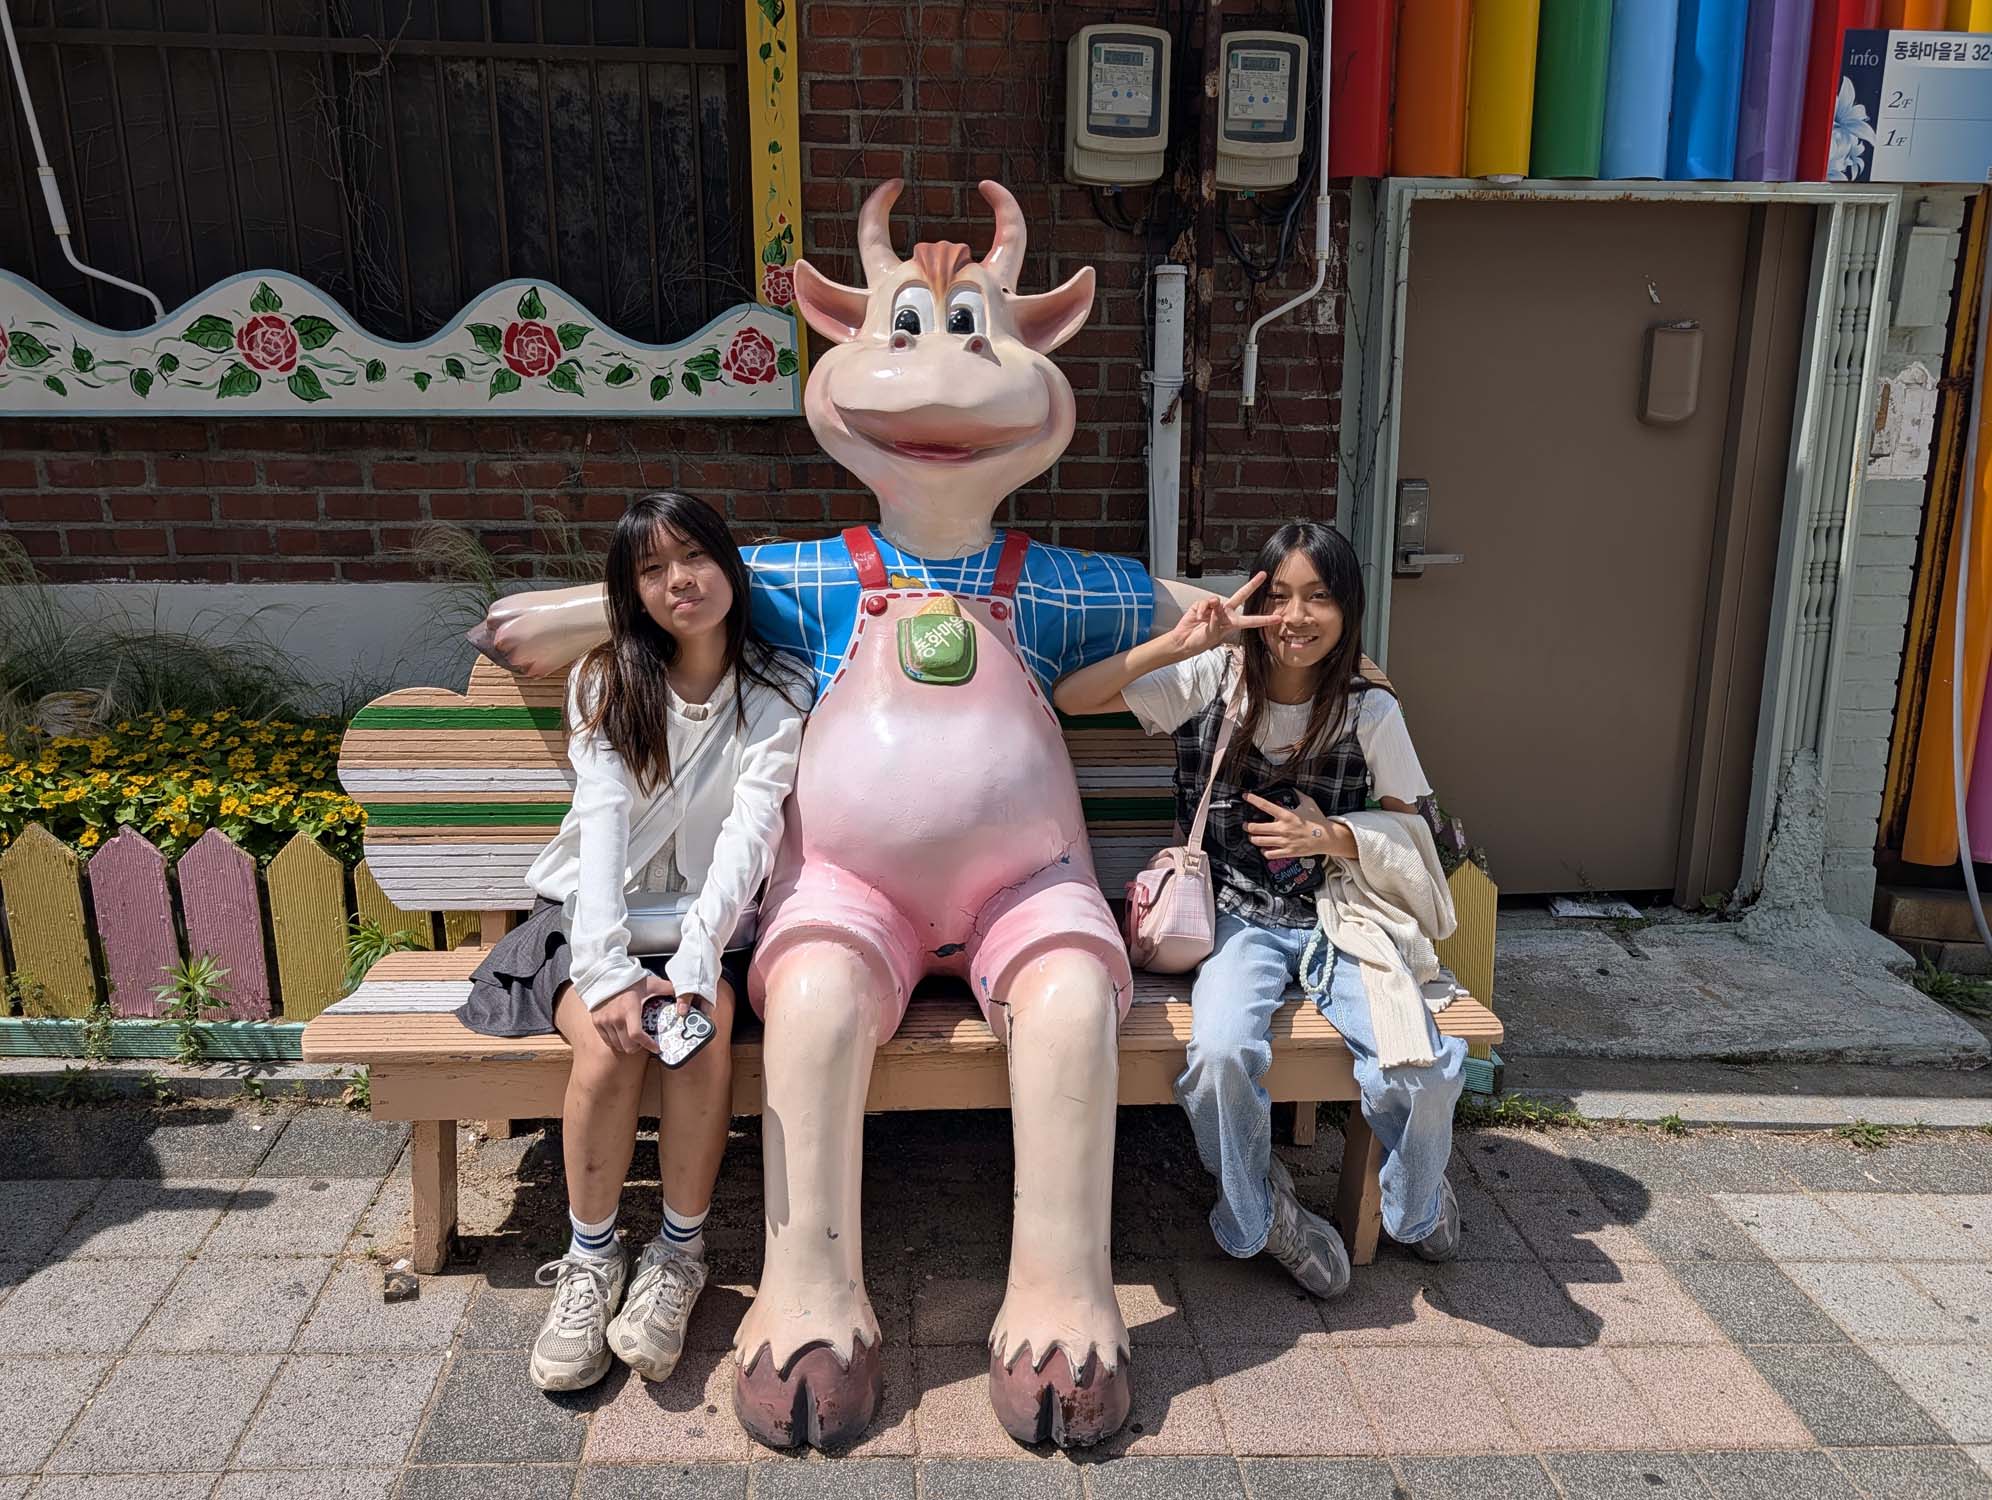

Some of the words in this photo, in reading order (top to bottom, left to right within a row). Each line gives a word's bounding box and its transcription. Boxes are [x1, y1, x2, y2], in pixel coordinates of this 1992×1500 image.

[1849, 49, 1879, 67] info
[1893, 41, 1968, 61] 동화마을길
[1887, 90, 1913, 109] 2F
[1882, 129, 1907, 147] 1F
